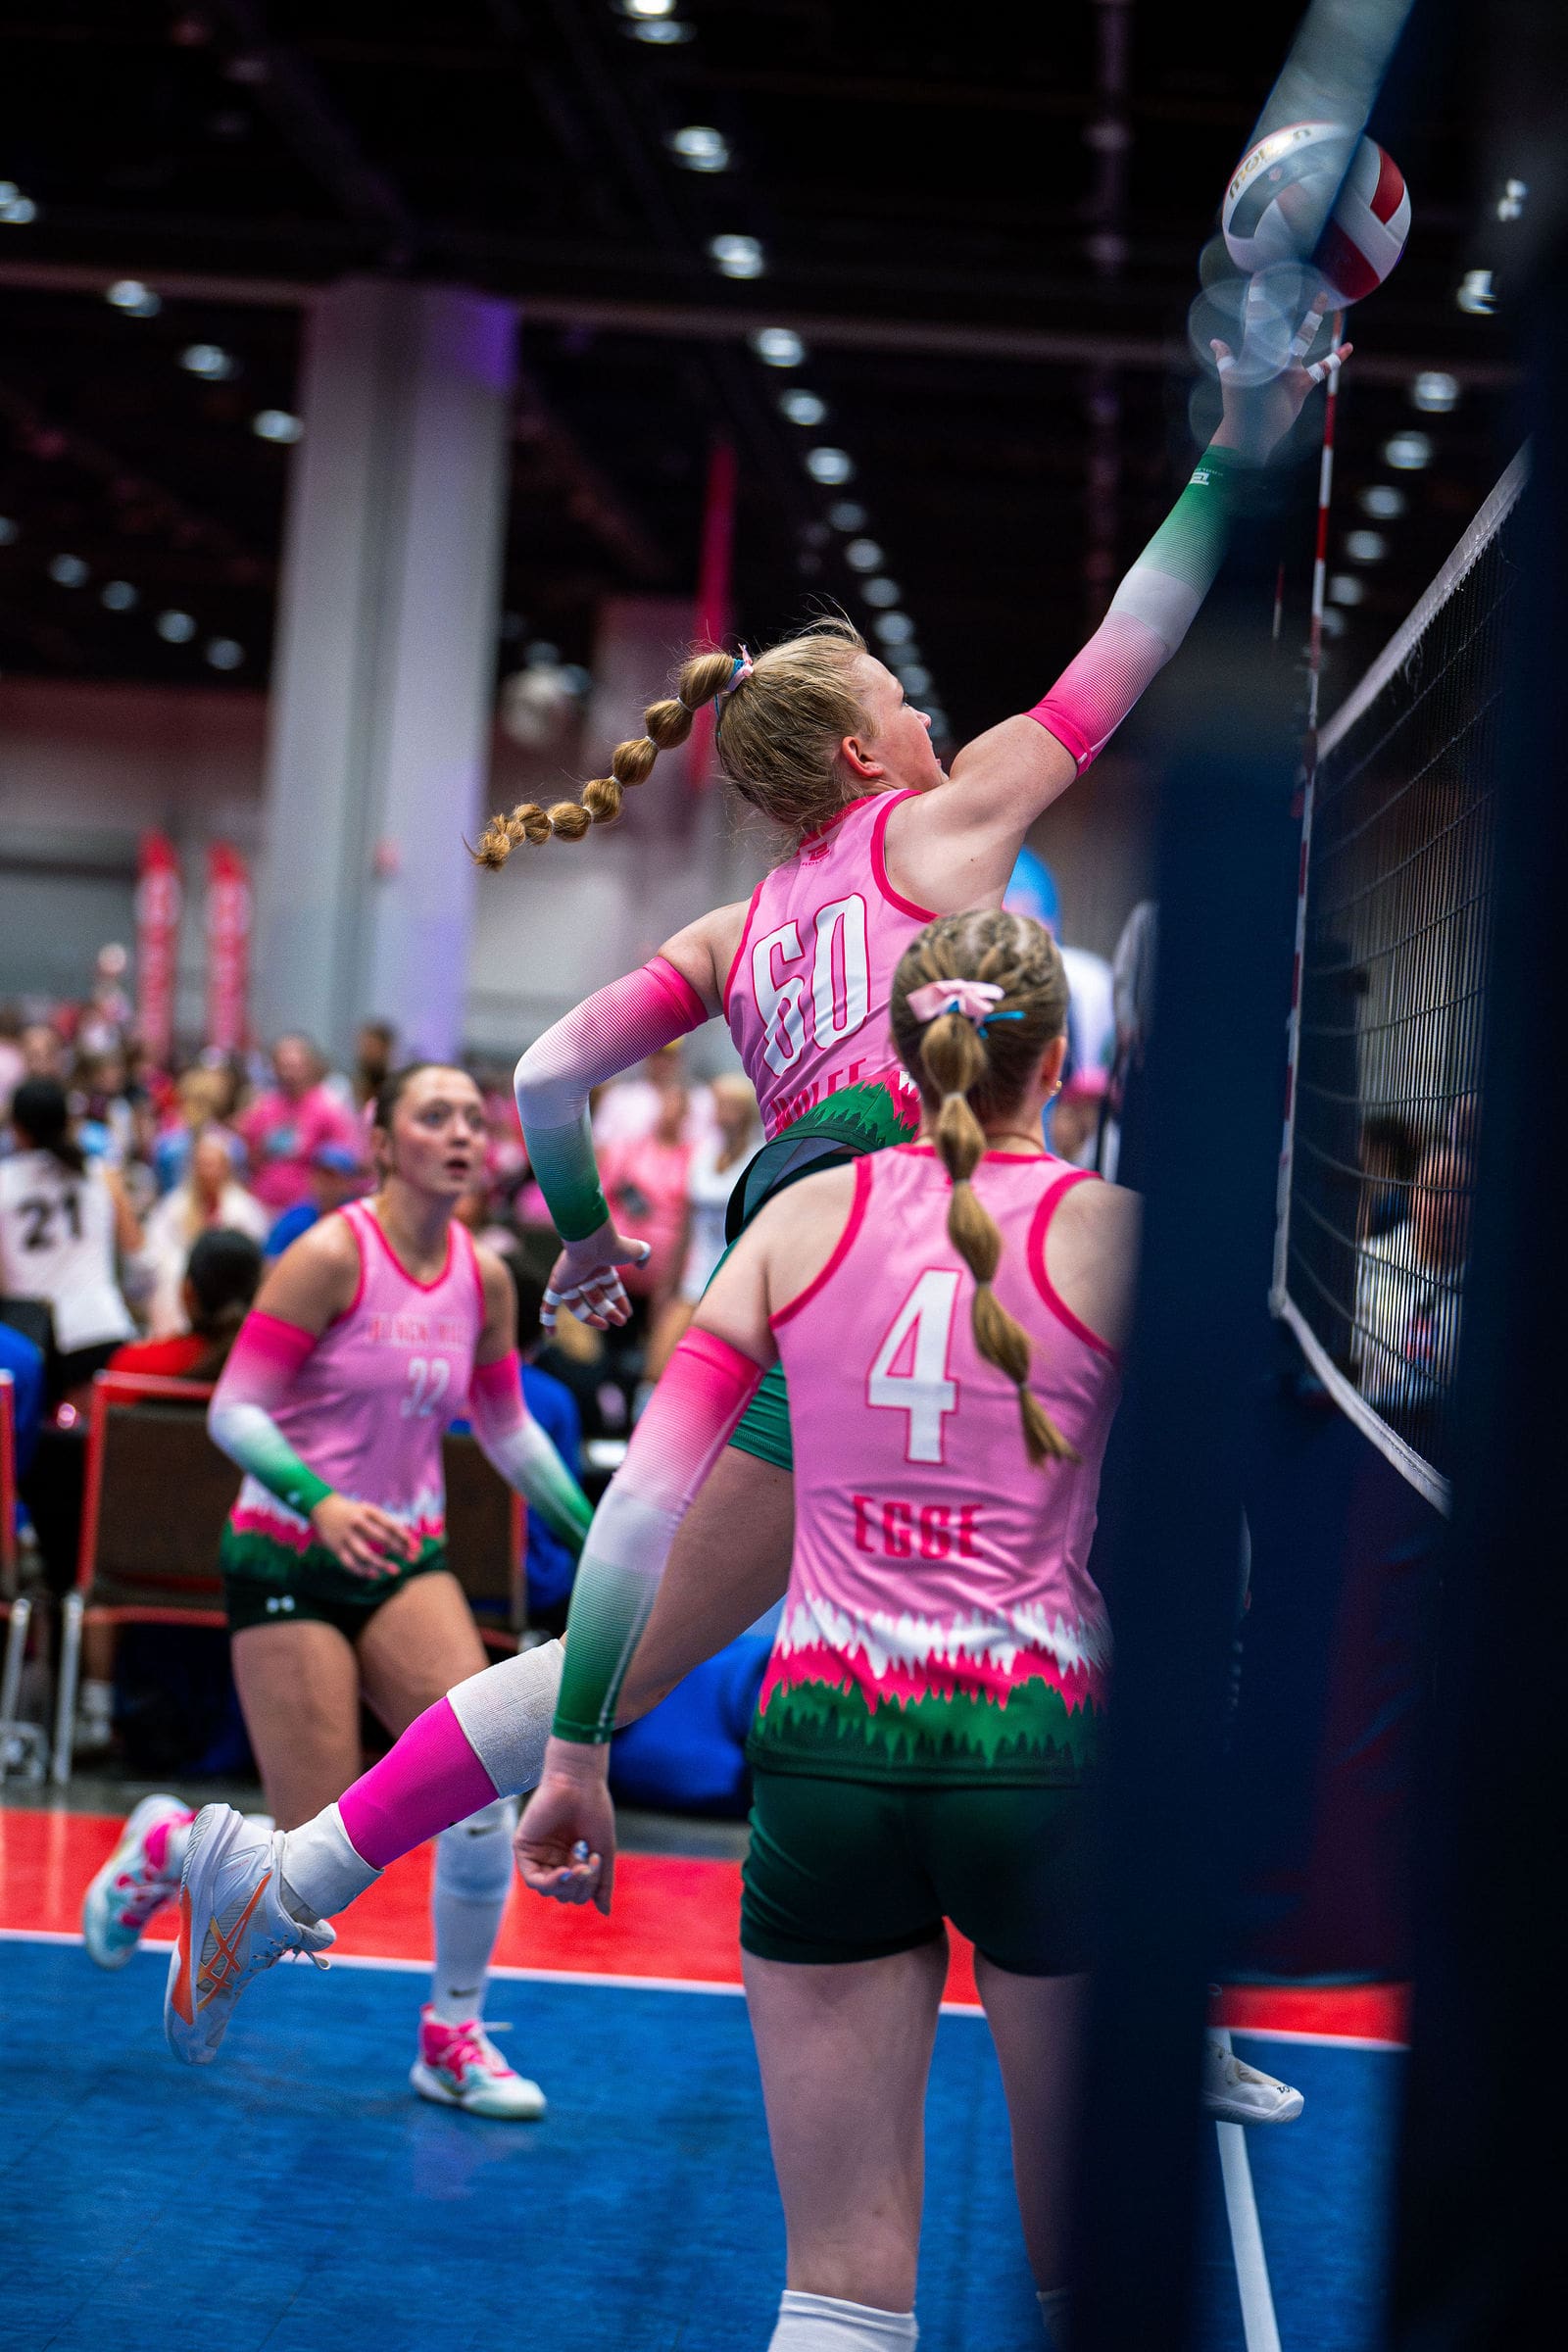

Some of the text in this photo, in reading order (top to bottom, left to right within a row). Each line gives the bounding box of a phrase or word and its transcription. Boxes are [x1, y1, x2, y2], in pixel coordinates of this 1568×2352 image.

[1228, 126, 1312, 200] moln
[752, 892, 871, 1079] 60
[17, 1192, 83, 1252] 21
[864, 1267, 963, 1466] 4
[854, 1494, 986, 1560] EGGE
